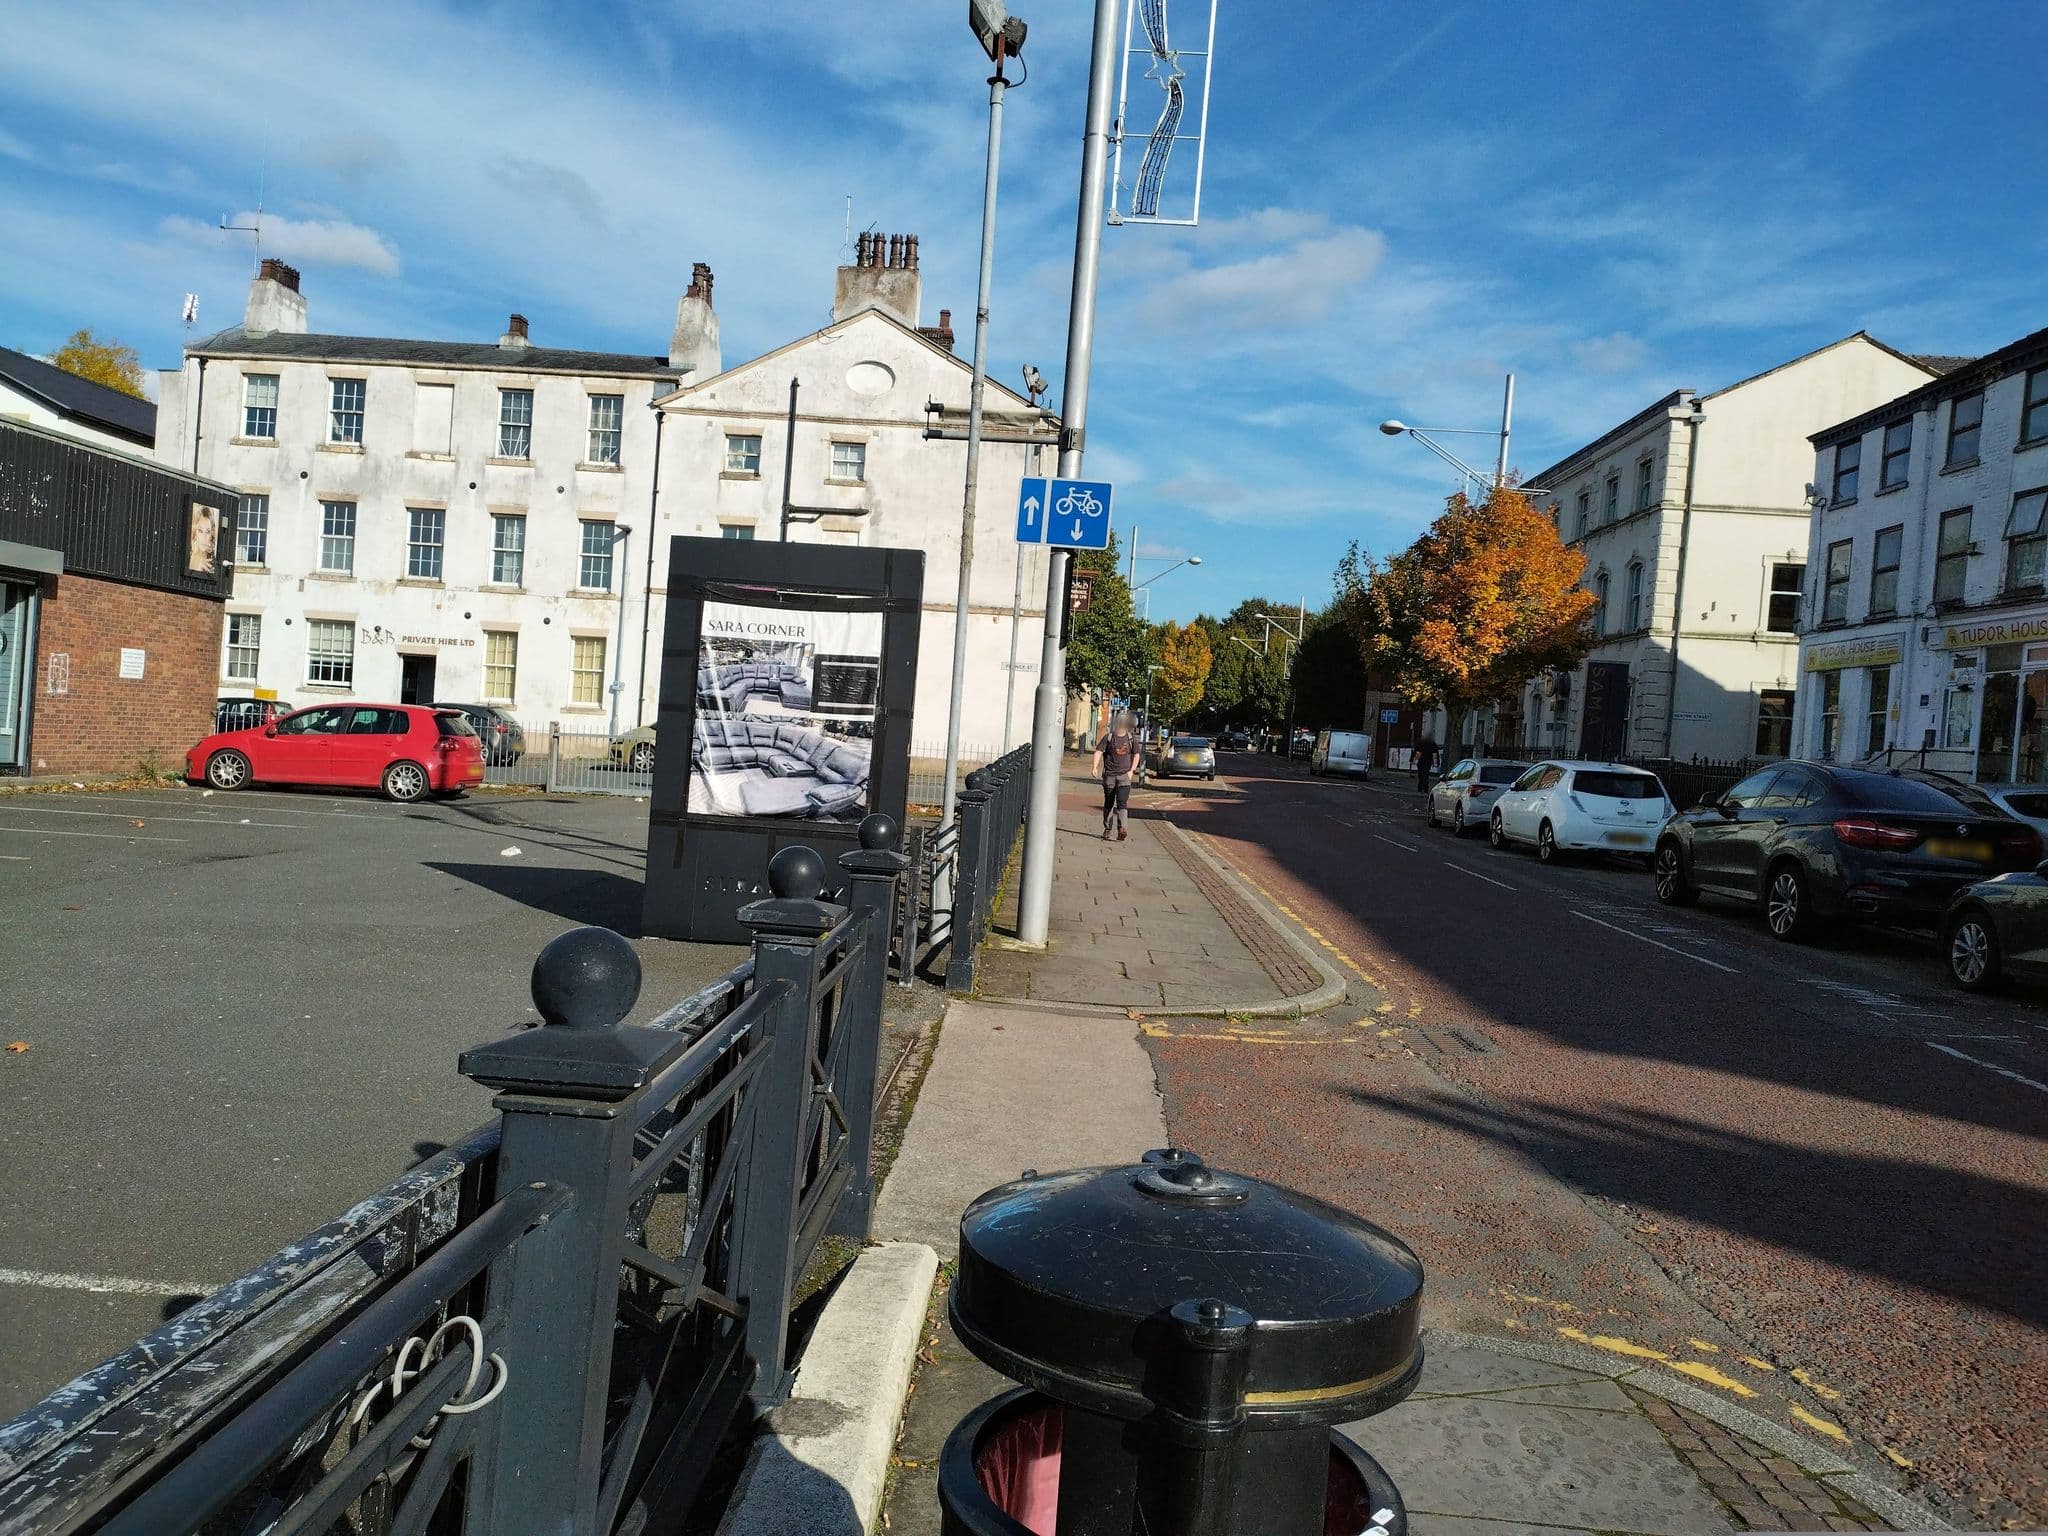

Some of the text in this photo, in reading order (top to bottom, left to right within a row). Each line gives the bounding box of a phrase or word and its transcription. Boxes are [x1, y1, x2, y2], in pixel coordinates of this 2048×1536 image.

[1730, 614, 1737, 622] T
[708, 620, 805, 637] SARA CORNER
[1960, 626, 2007, 643] TUDOR
[360, 628, 475, 647] B&B PRIVATE HIRE LTD
[1820, 645, 1846, 658] TUDOR
[1848, 640, 1878, 654] HOUSE
